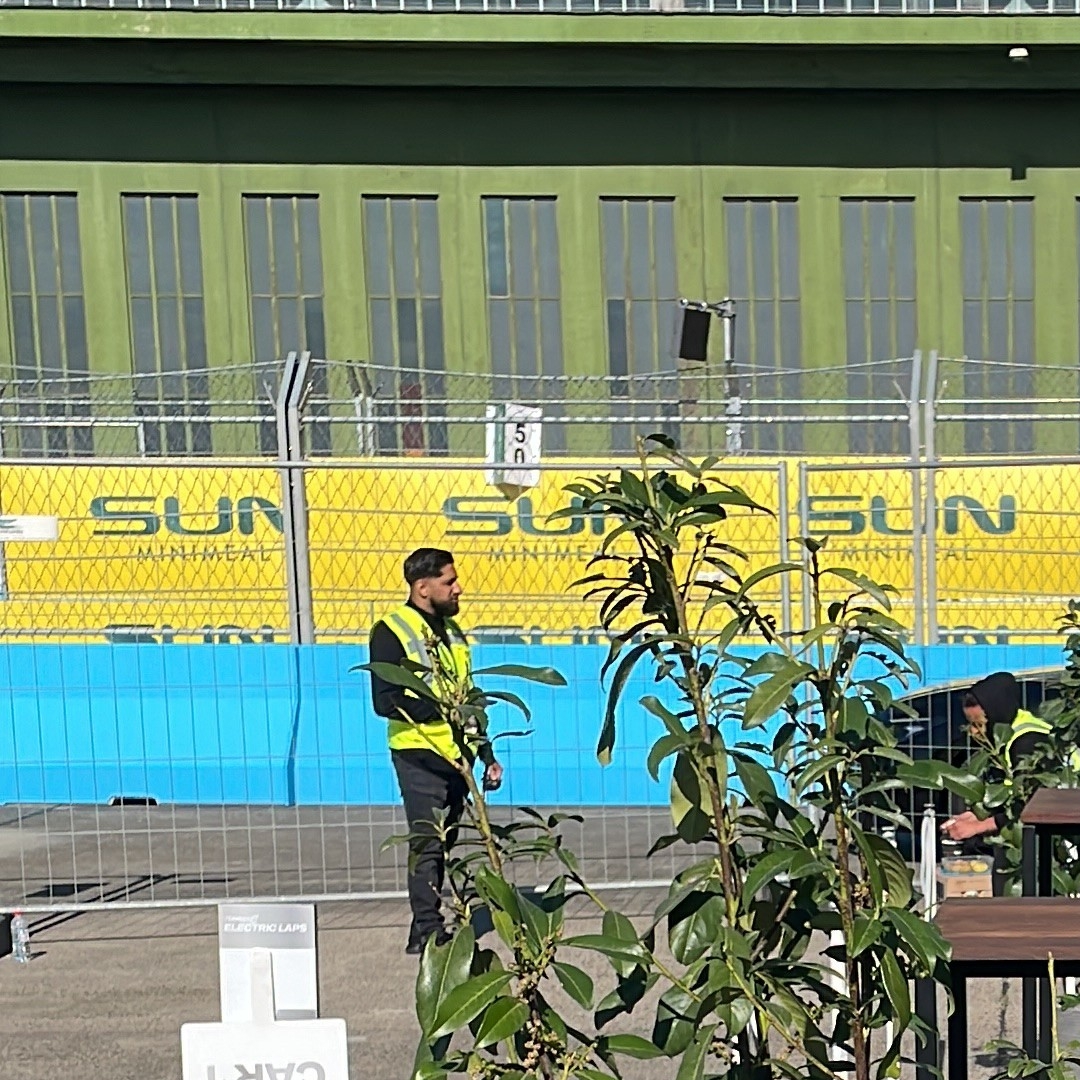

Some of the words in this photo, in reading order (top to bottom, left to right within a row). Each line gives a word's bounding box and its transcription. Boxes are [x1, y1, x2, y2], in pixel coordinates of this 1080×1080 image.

[91, 496, 284, 535] SUN
[798, 495, 1016, 535] SUN
[137, 543, 272, 562] MINIMEAL
[223, 922, 277, 933] ELECTRIC
[277, 922, 308, 934] LAPS
